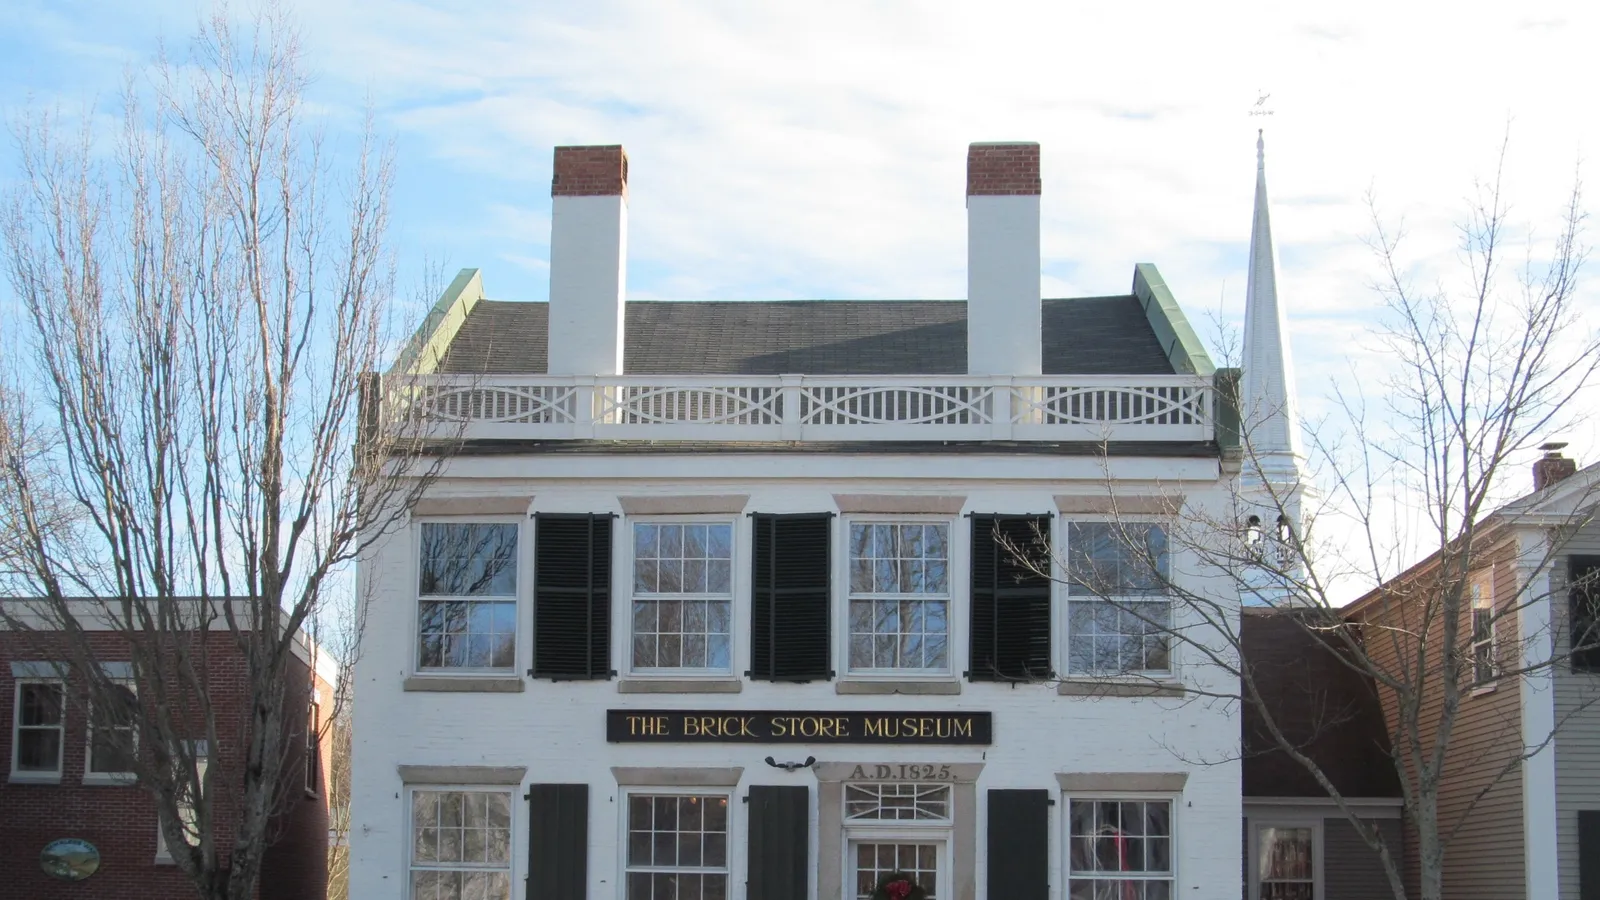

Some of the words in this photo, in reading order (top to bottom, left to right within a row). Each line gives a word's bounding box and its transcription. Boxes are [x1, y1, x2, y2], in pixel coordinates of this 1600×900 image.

[626, 716, 670, 736] THE
[683, 716, 760, 738] BRICK
[771, 717, 850, 737] STORE
[863, 718, 973, 738] MUSEUM
